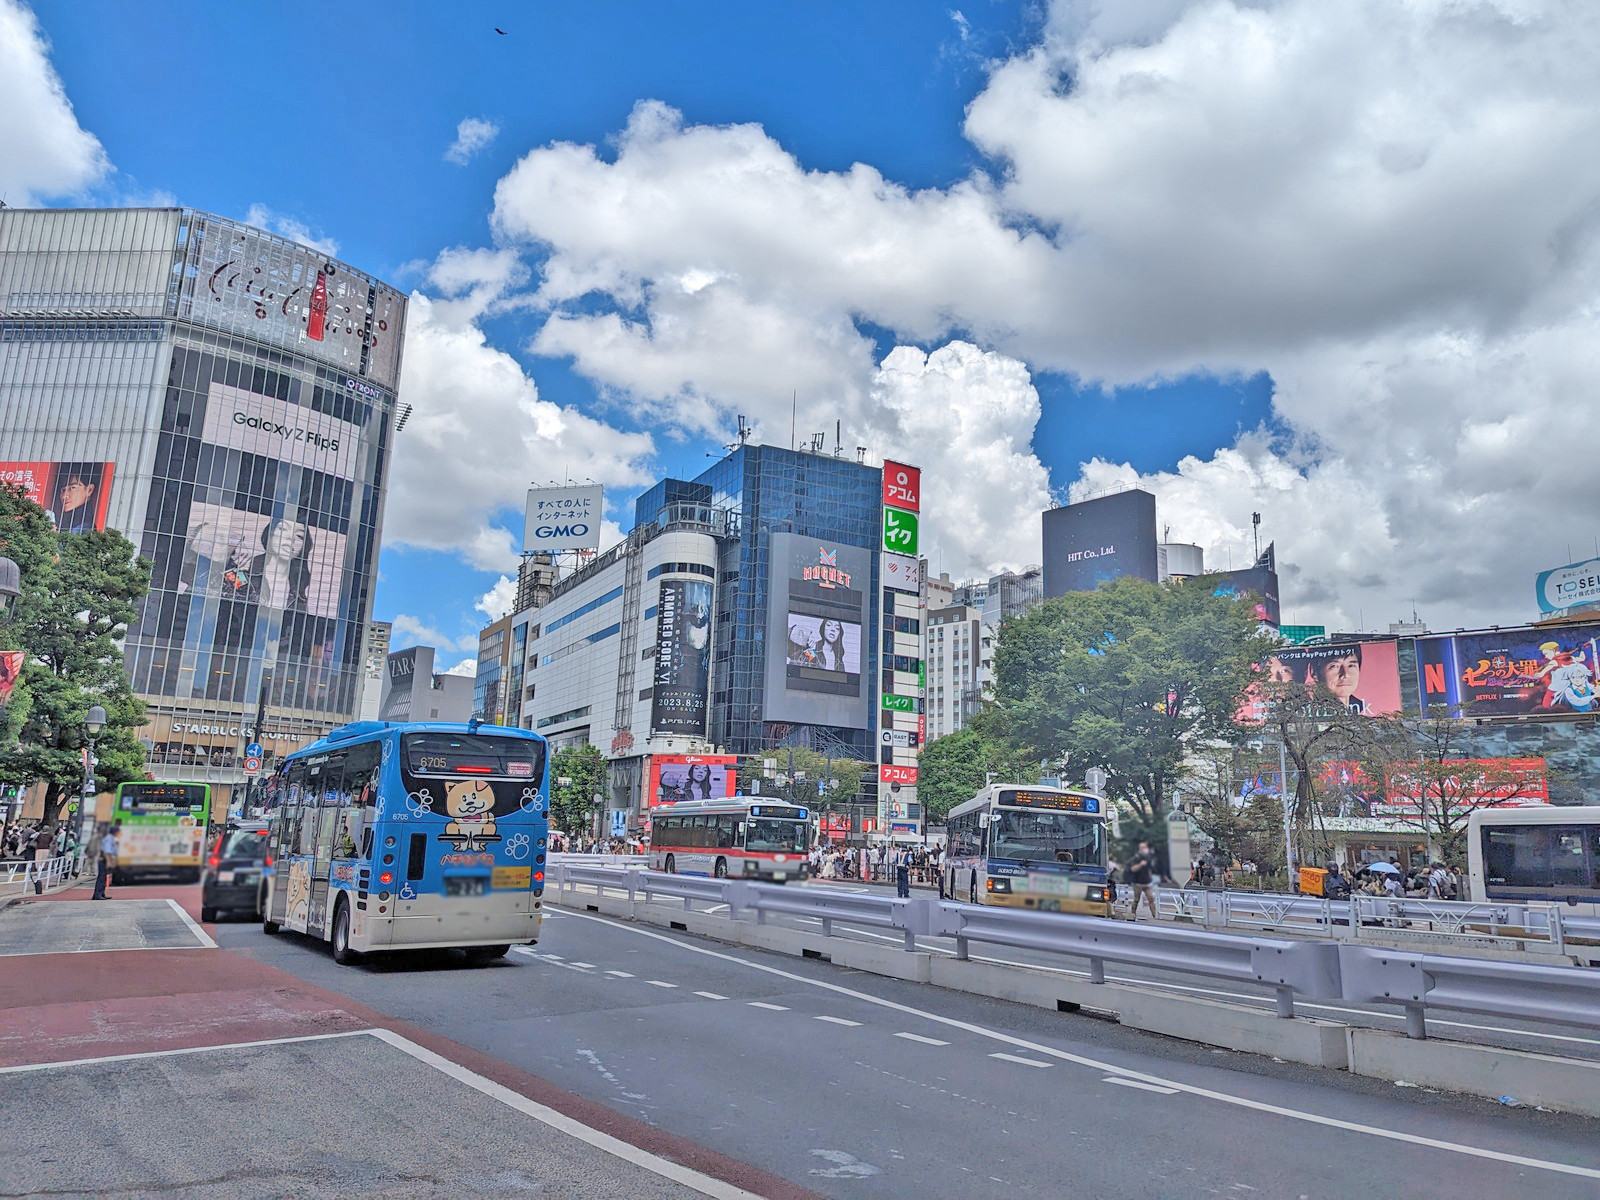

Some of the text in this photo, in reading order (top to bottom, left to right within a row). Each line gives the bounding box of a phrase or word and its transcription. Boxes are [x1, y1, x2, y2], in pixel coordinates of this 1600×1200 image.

[233, 412, 339, 451] Galaxy Z Flip5
[887, 484, 916, 503] アコム
[538, 498, 591, 510] すべての人に
[537, 509, 590, 521] インターネット
[535, 524, 589, 538] GMO
[1068, 545, 1116, 562] HIT Co., Ltd.
[803, 565, 851, 588] MAGNET
[663, 588, 675, 637] ARMORED
[660, 640, 673, 668] CORE
[659, 671, 671, 685] VI
[1424, 664, 1446, 693] N
[1462, 659, 1538, 687] 七つの大罪
[658, 698, 704, 708] 2023.8.25
[886, 697, 908, 708] レイク
[173, 722, 255, 738] STARBUCKS
[420, 757, 447, 768] 6705
[884, 769, 907, 779] アコム
